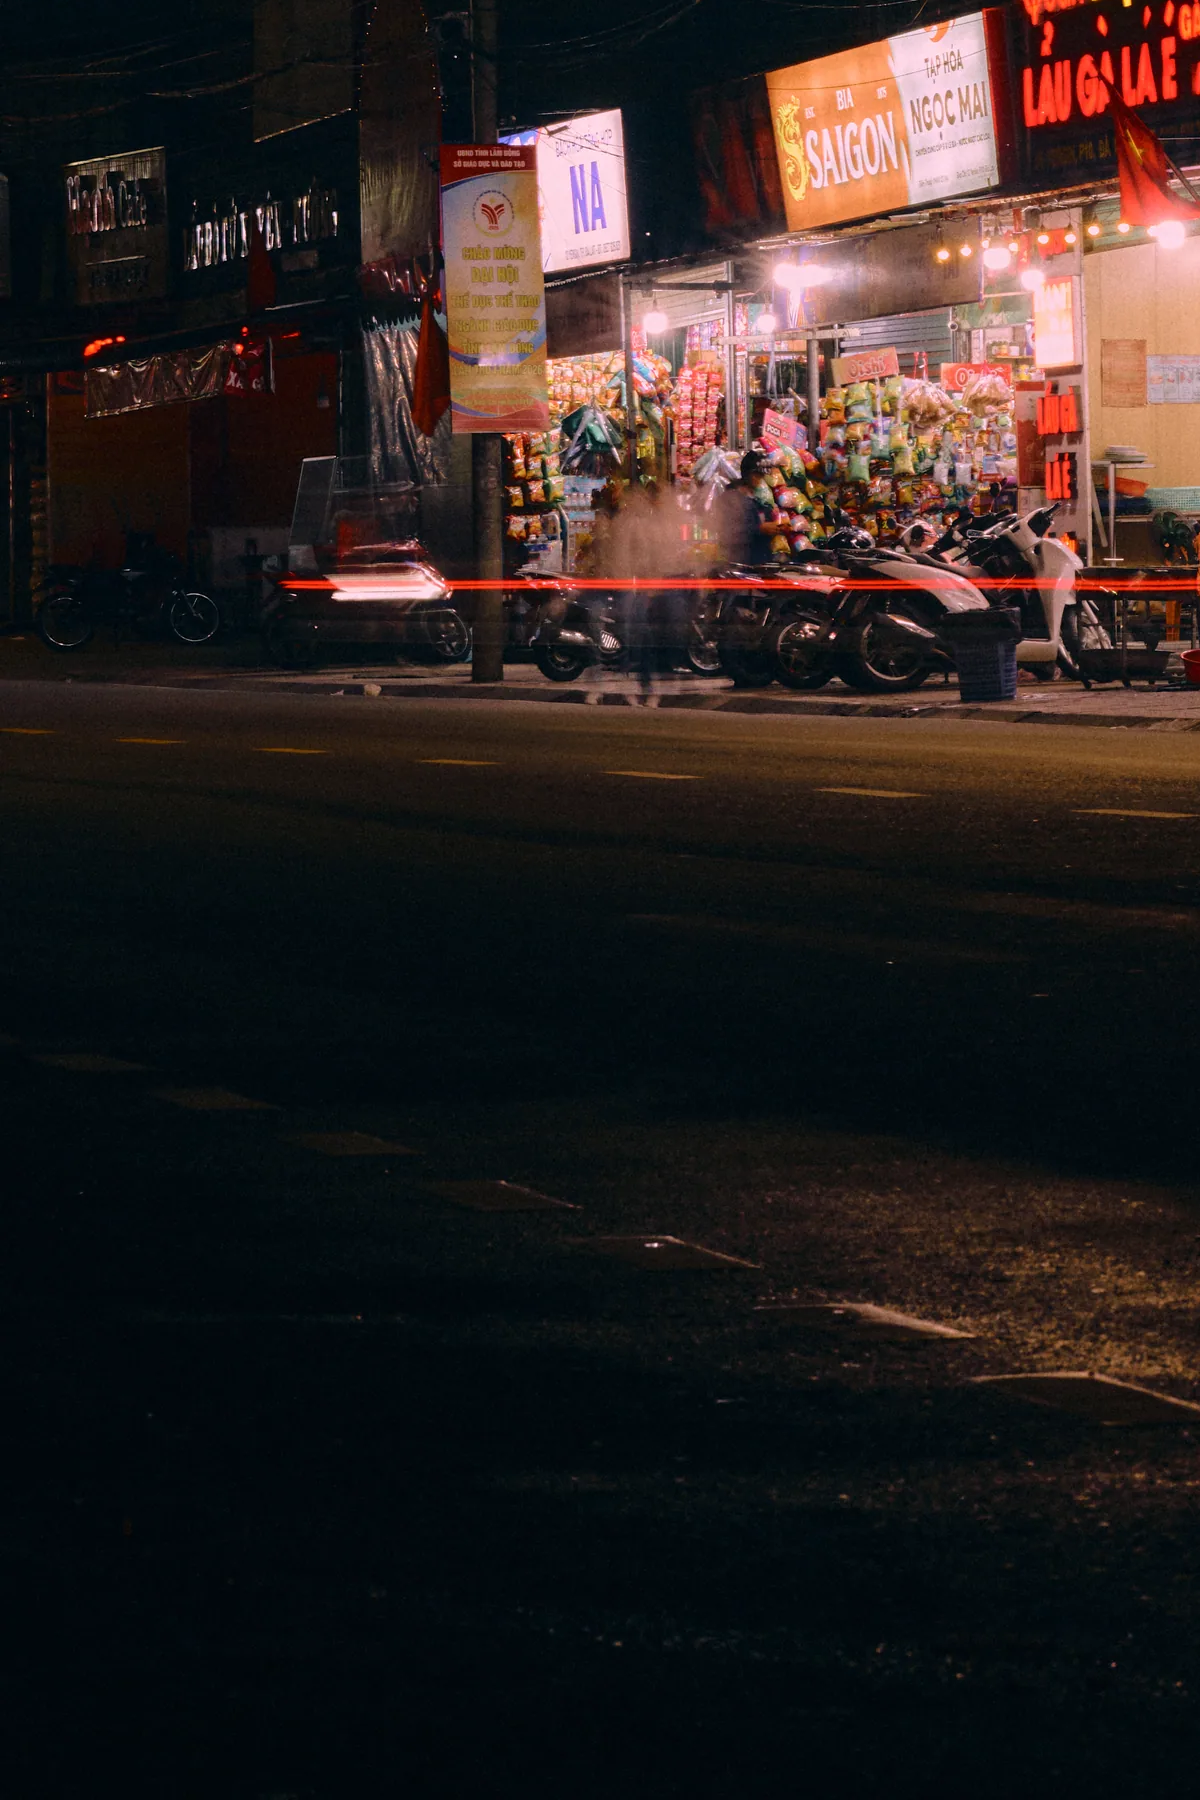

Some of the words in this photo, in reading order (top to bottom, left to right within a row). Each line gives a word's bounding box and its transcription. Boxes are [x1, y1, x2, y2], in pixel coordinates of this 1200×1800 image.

[924, 54, 941, 84] TẠP
[944, 44, 964, 74] HÓA
[1023, 21, 1071, 128] LẨU
[1076, 15, 1114, 117] GÀ
[1122, 6, 1157, 107] LÁ
[836, 88, 854, 111] BIA
[910, 90, 956, 140] NGỌC
[958, 81, 988, 123] MAI
[805, 111, 898, 190] SAIGON
[570, 161, 607, 234] NA
[462, 244, 492, 260] CHÀO
[494, 244, 526, 260] MỪNG
[471, 266, 493, 286] ĐẠI
[497, 264, 519, 284] HỘI
[516, 294, 540, 308] THAO
[523, 364, 542, 375] 2026
[848, 353, 886, 378] Oishi
[767, 424, 780, 437] POCA
